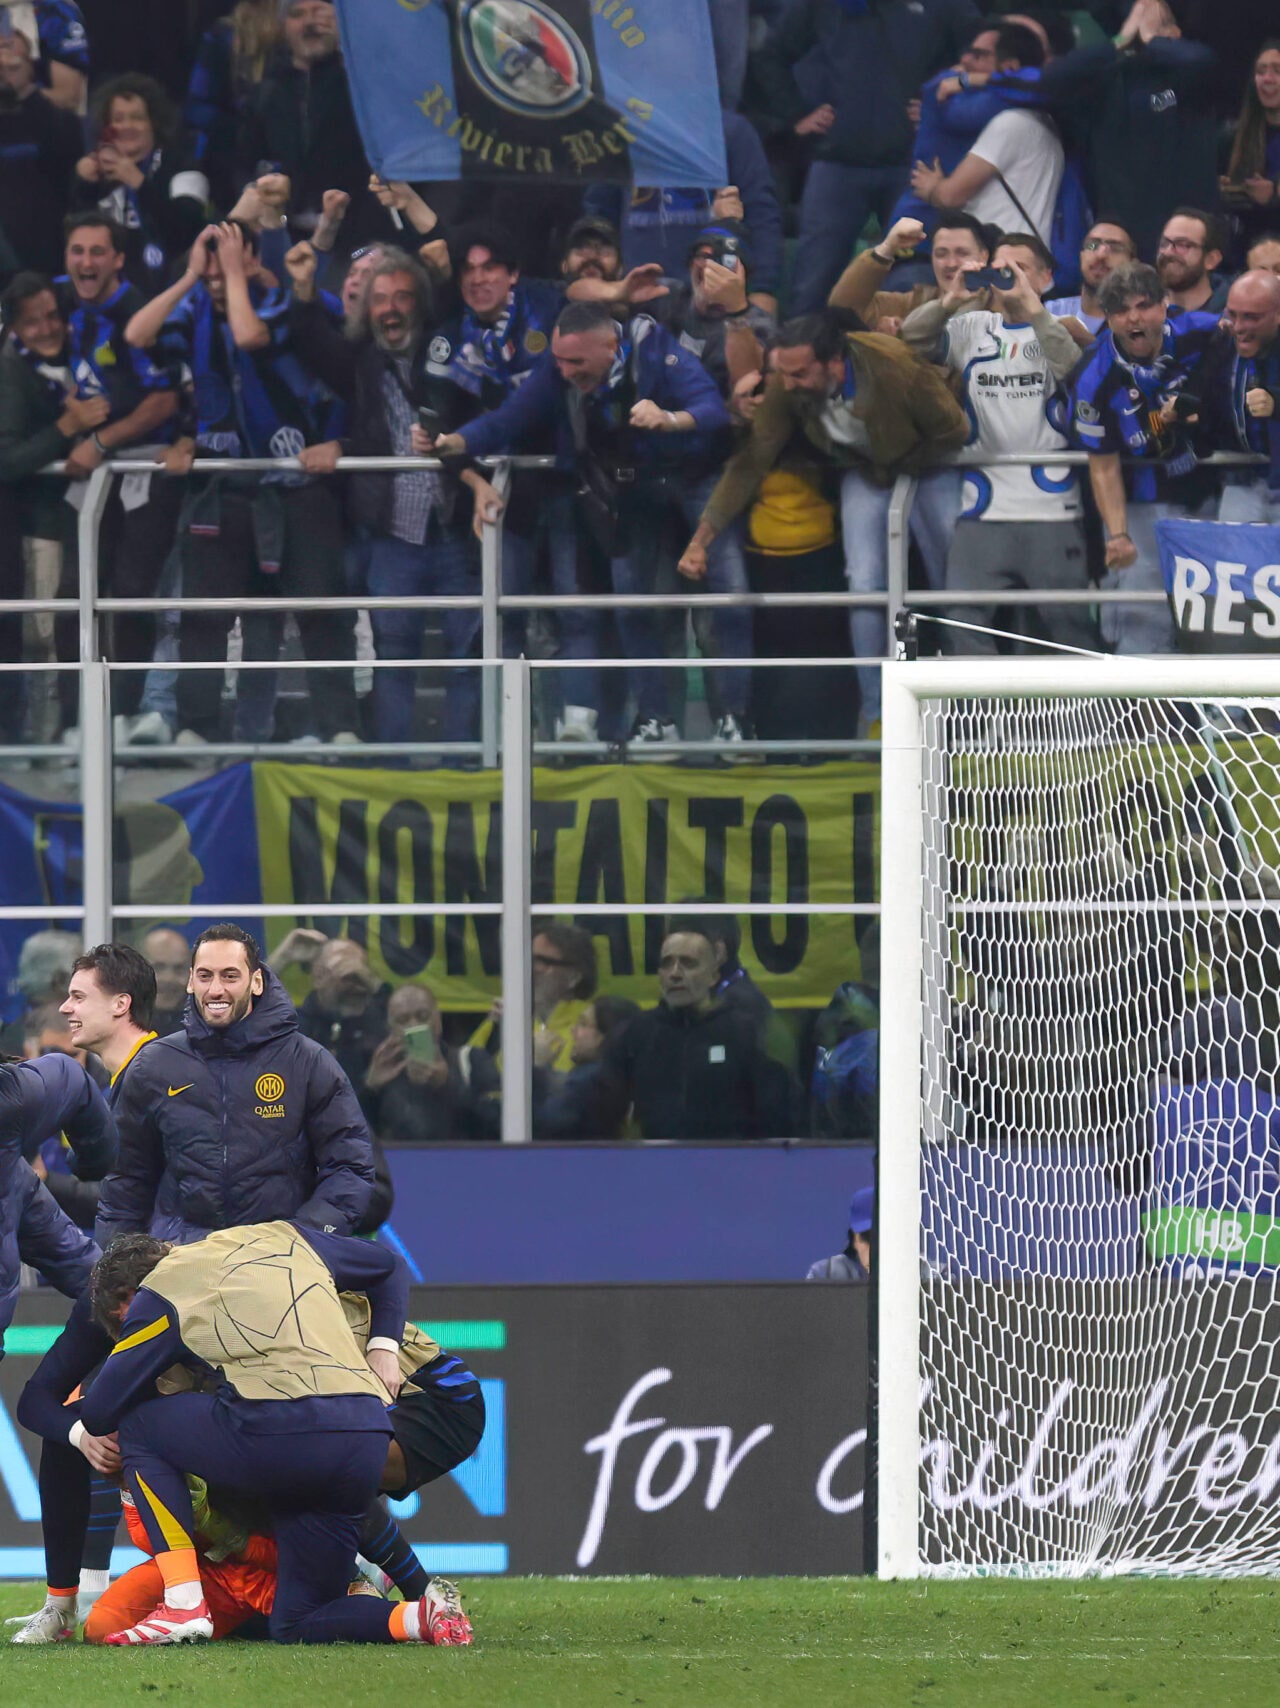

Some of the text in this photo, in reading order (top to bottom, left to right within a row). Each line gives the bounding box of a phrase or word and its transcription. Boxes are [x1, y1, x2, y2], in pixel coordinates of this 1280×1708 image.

[414, 80, 553, 173] Riviera
[254, 1104, 285, 1116] QATAR
[1194, 1217, 1244, 1252] HB
[576, 1367, 774, 1568] for
